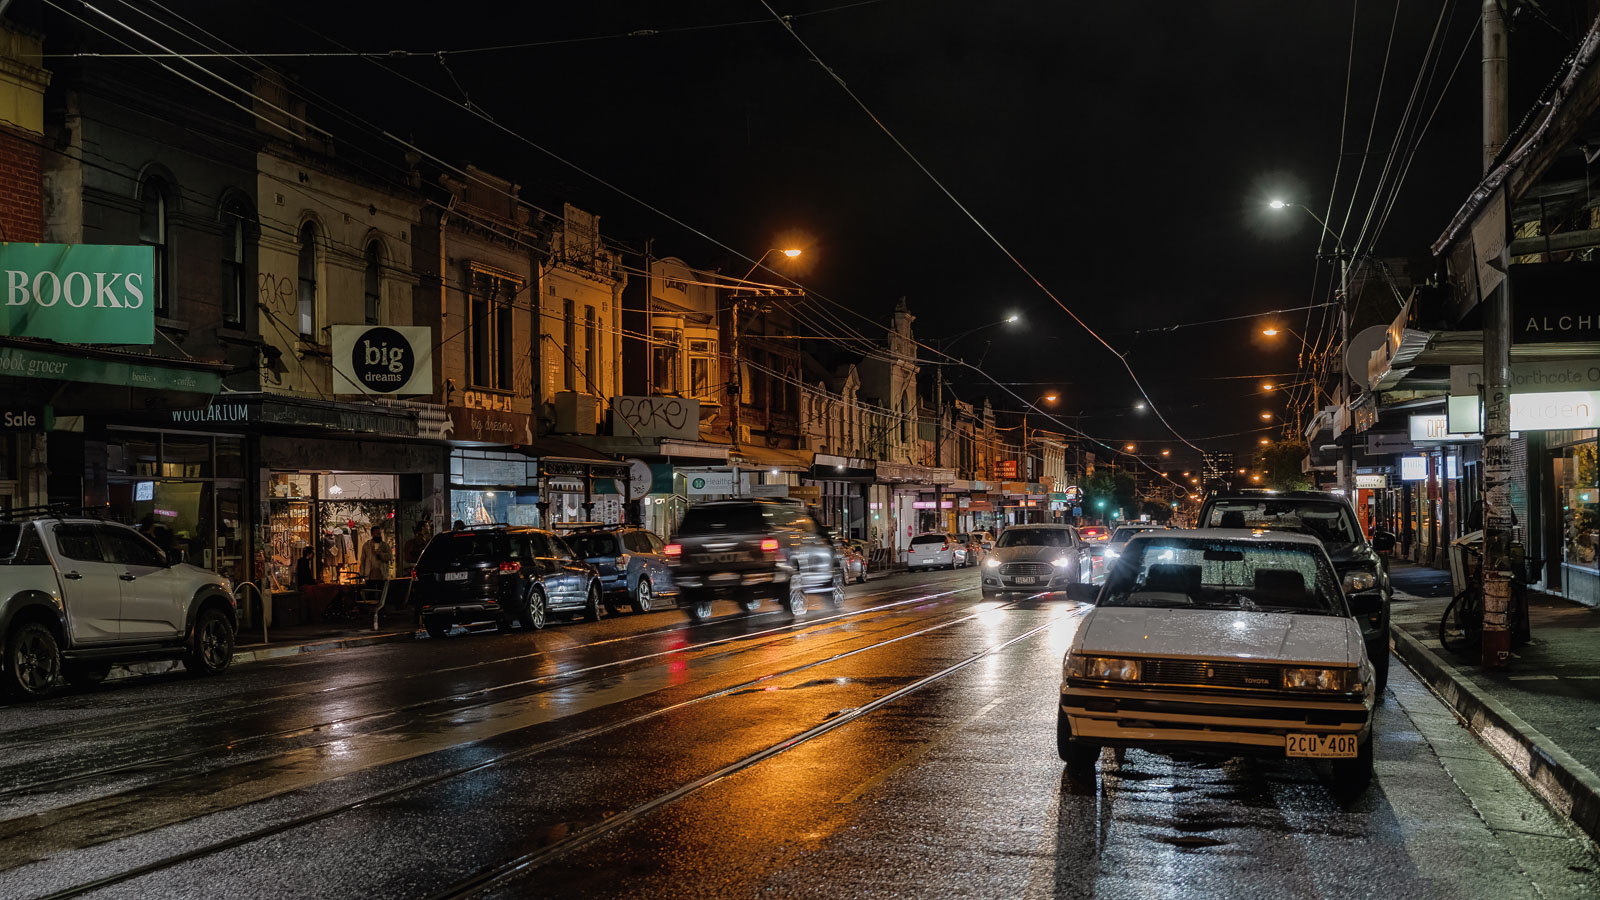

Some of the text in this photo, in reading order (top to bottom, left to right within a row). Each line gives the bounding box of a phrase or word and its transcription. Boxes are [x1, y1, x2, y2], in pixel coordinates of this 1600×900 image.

[4, 270, 144, 309] BOOKS
[1525, 315, 1600, 332] ALCH
[0, 353, 68, 376] ook grocer
[363, 339, 404, 373] big
[364, 371, 402, 382] dreams
[3, 410, 37, 427] Sale
[172, 403, 248, 422] WOOLARIUM
